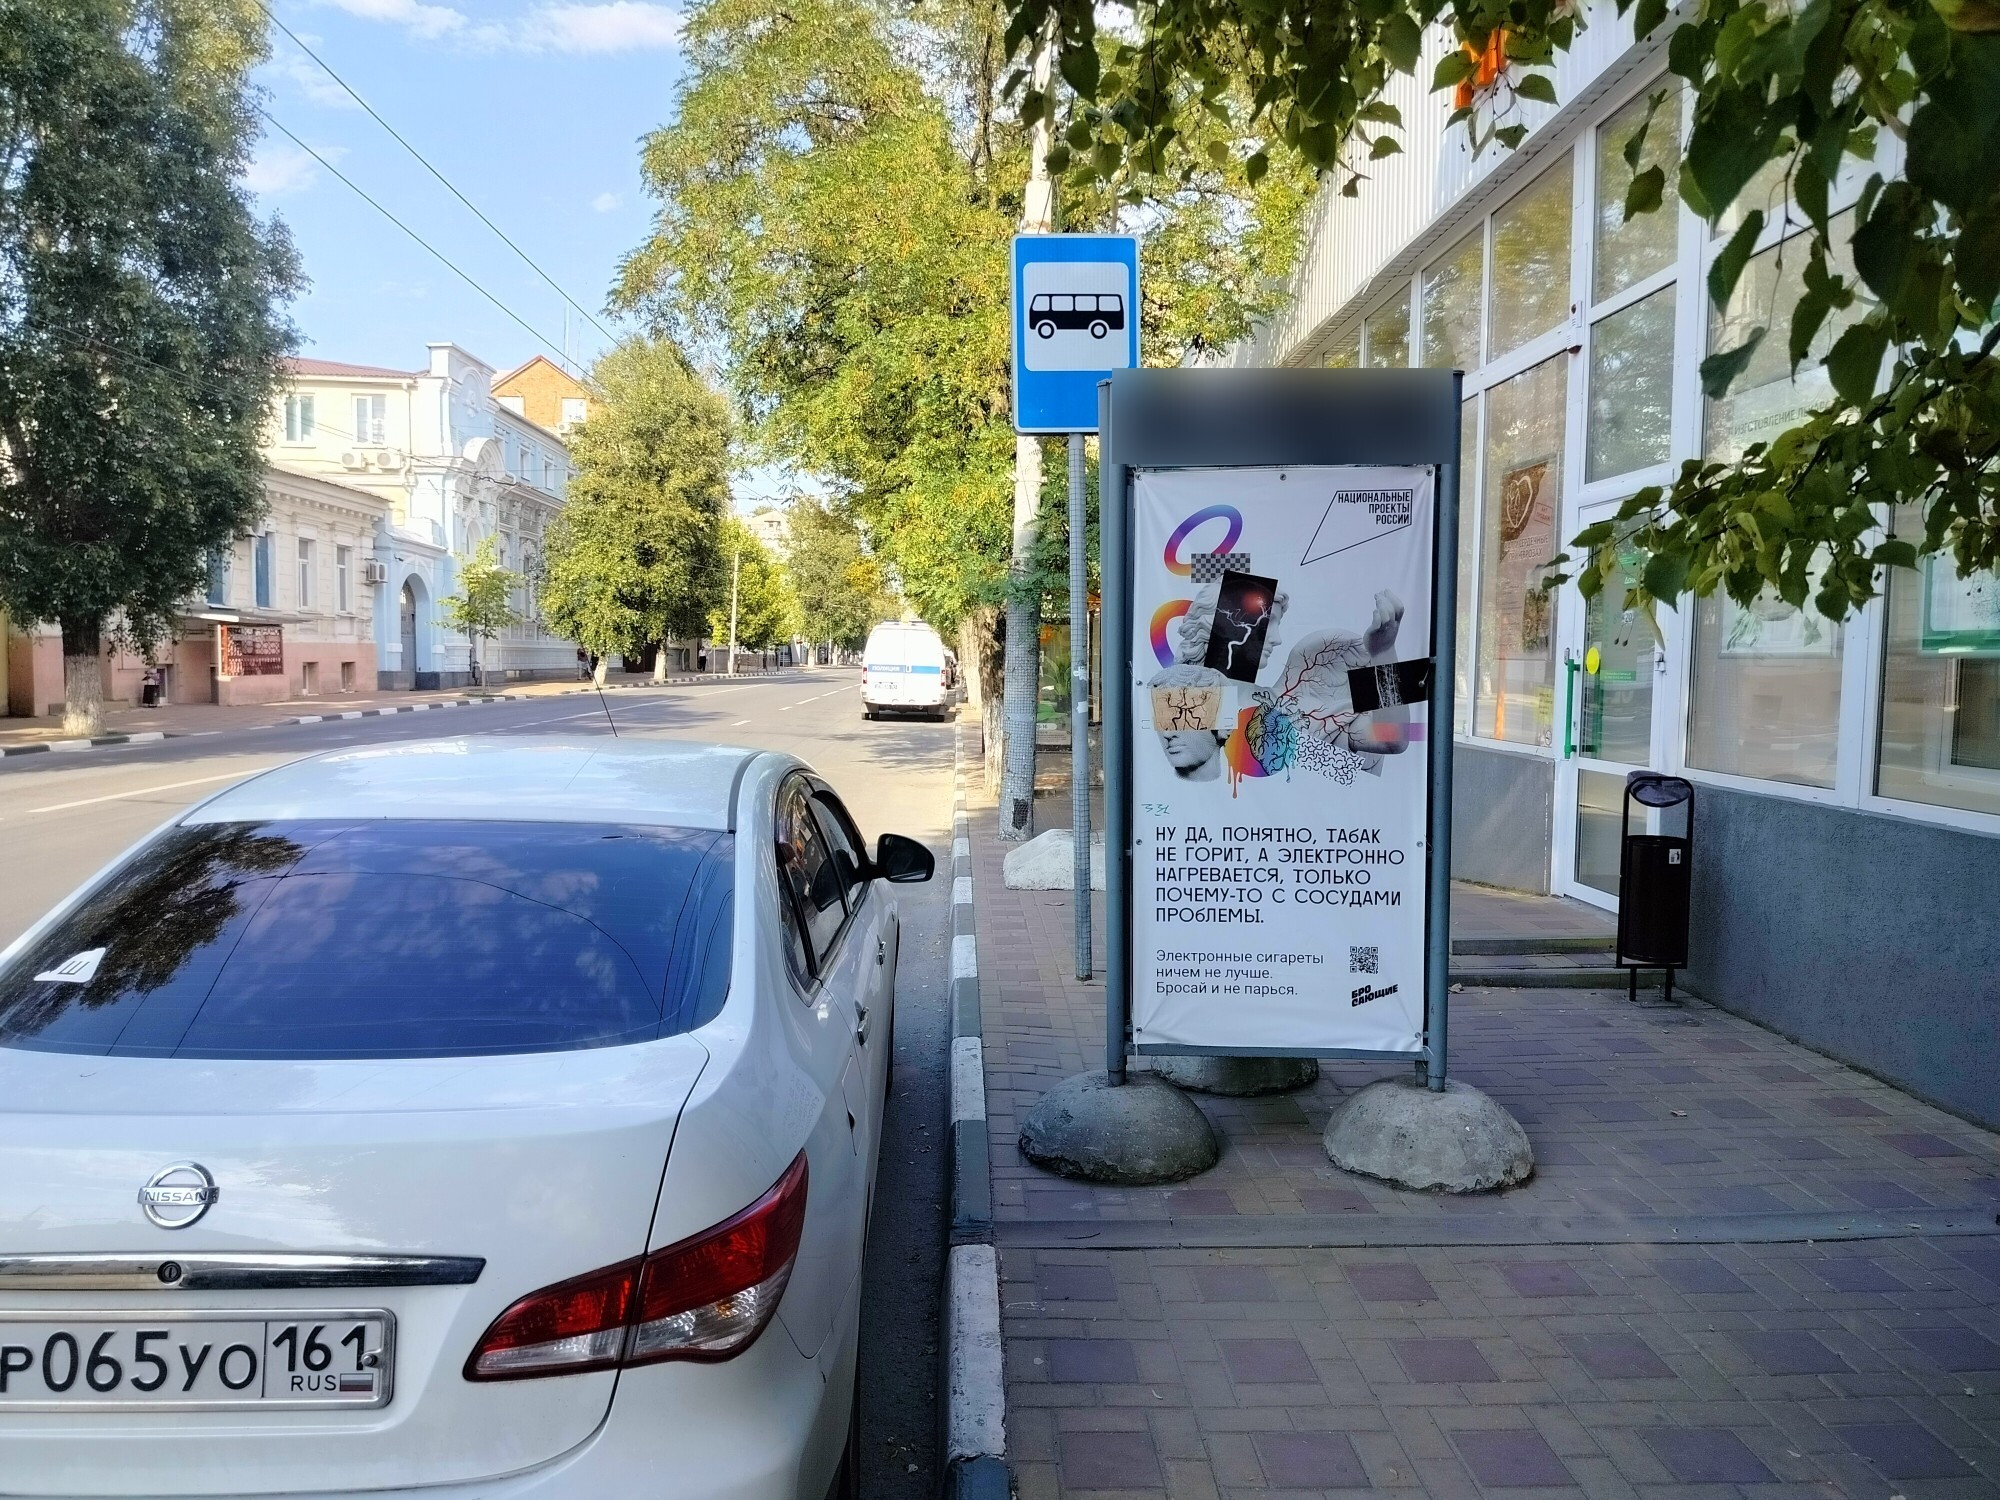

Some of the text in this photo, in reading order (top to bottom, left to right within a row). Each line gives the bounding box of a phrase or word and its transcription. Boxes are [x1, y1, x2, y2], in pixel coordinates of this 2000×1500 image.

[1337, 491, 1411, 504] НАЦИОНАЛЬНЫЕ
[1368, 503, 1410, 514] ПРОЕКТЫ
[1375, 514, 1410, 525] РОССИИ
[1156, 826, 1177, 842] НУ
[1184, 826, 1213, 845] ДА,
[1222, 826, 1317, 845] ПОНЯТНО,
[1156, 846, 1405, 866] НЕ ГОРИТ, А ЭЛЕКТРОННО
[1156, 866, 1371, 885] НАГРЕВАЕТСЯ, ТОЛЬКО
[1156, 887, 1401, 908] ПОЧЕМУ-ТО С СОСУДАМИ
[1156, 949, 1324, 966] Электронные сигареты
[1156, 968, 1273, 981] ничем не лучше.
[1156, 981, 1298, 998] Бросай и не парься.
[1351, 984, 1372, 999] БРО
[1351, 984, 1399, 1008] САЮЩИЕ
[144, 1190, 208, 1202] NISSAN
[271, 1323, 366, 1372] 161
[290, 1374, 337, 1392] RUS
